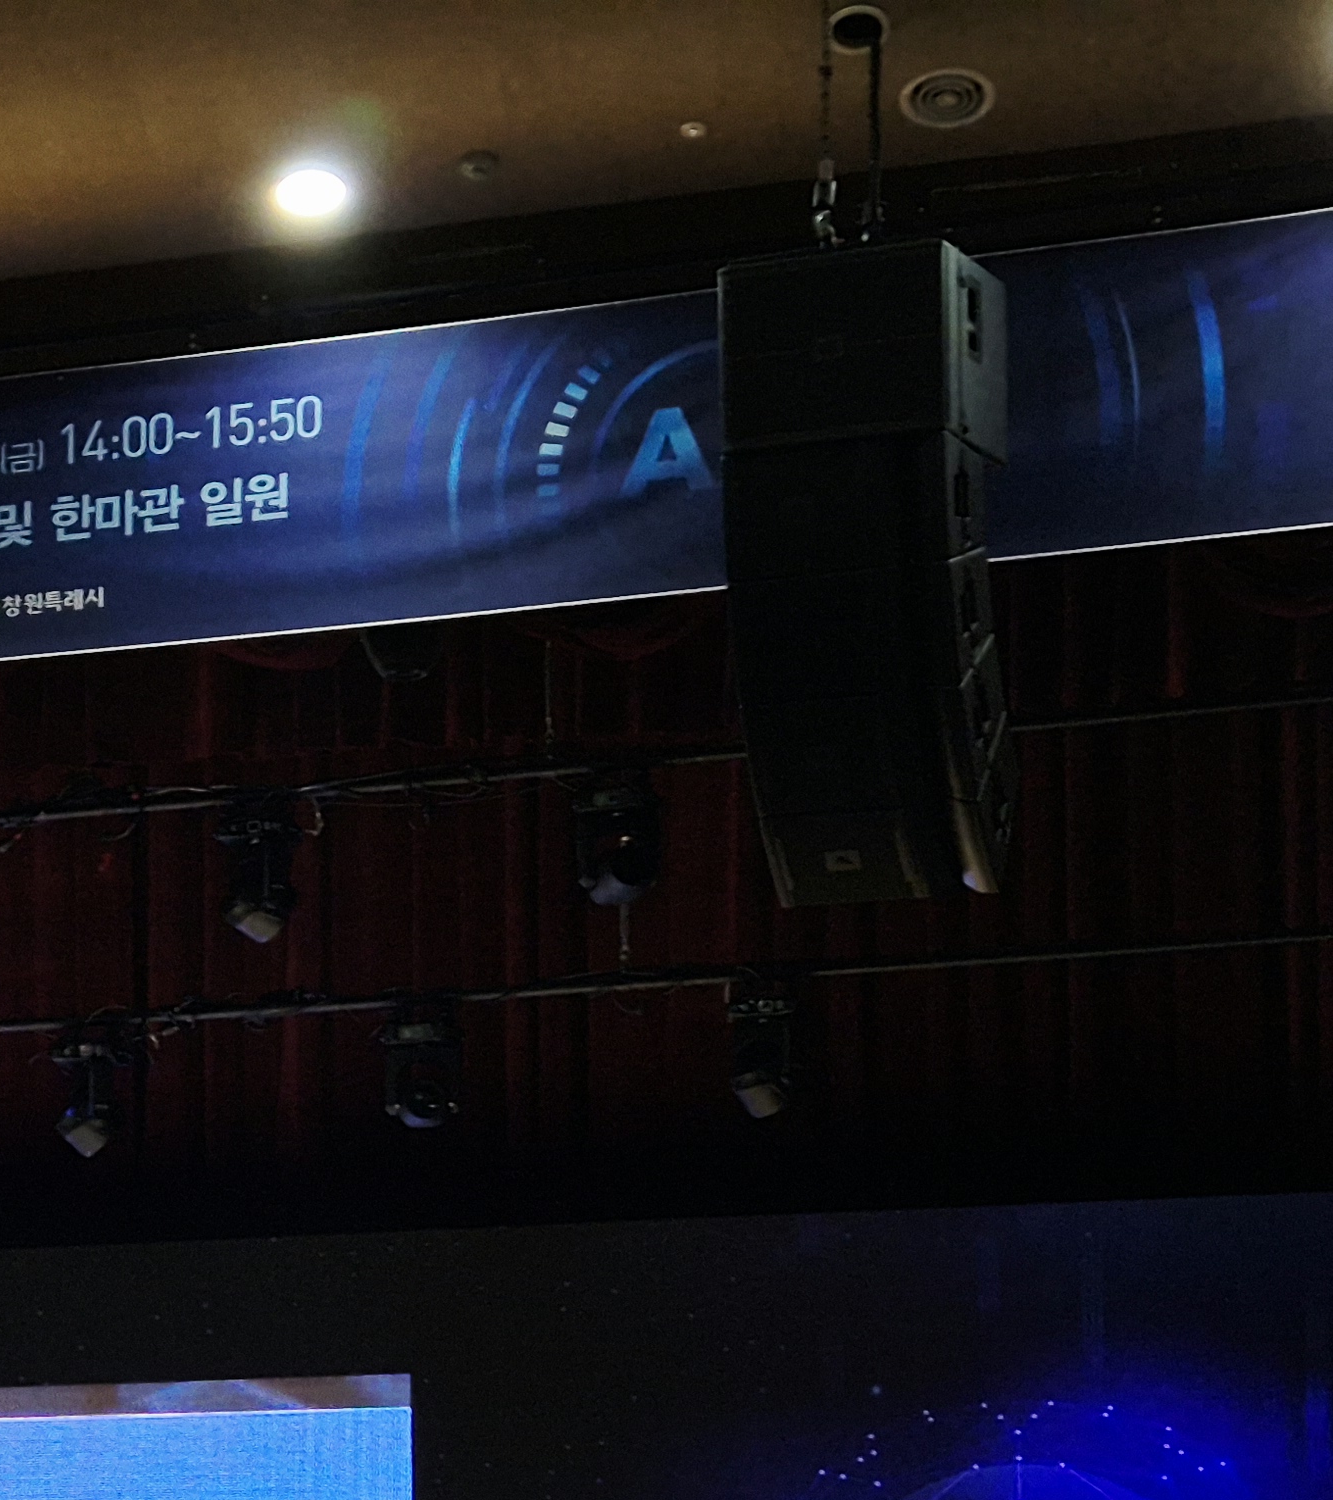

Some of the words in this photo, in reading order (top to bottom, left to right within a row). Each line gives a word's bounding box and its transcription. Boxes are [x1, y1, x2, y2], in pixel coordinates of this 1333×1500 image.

[60, 394, 324, 465] 14:00~15:50
[622, 406, 712, 497] A
[50, 483, 185, 543] 한마관
[200, 472, 291, 529] 일원
[1, 586, 105, 618] 창원특례시
